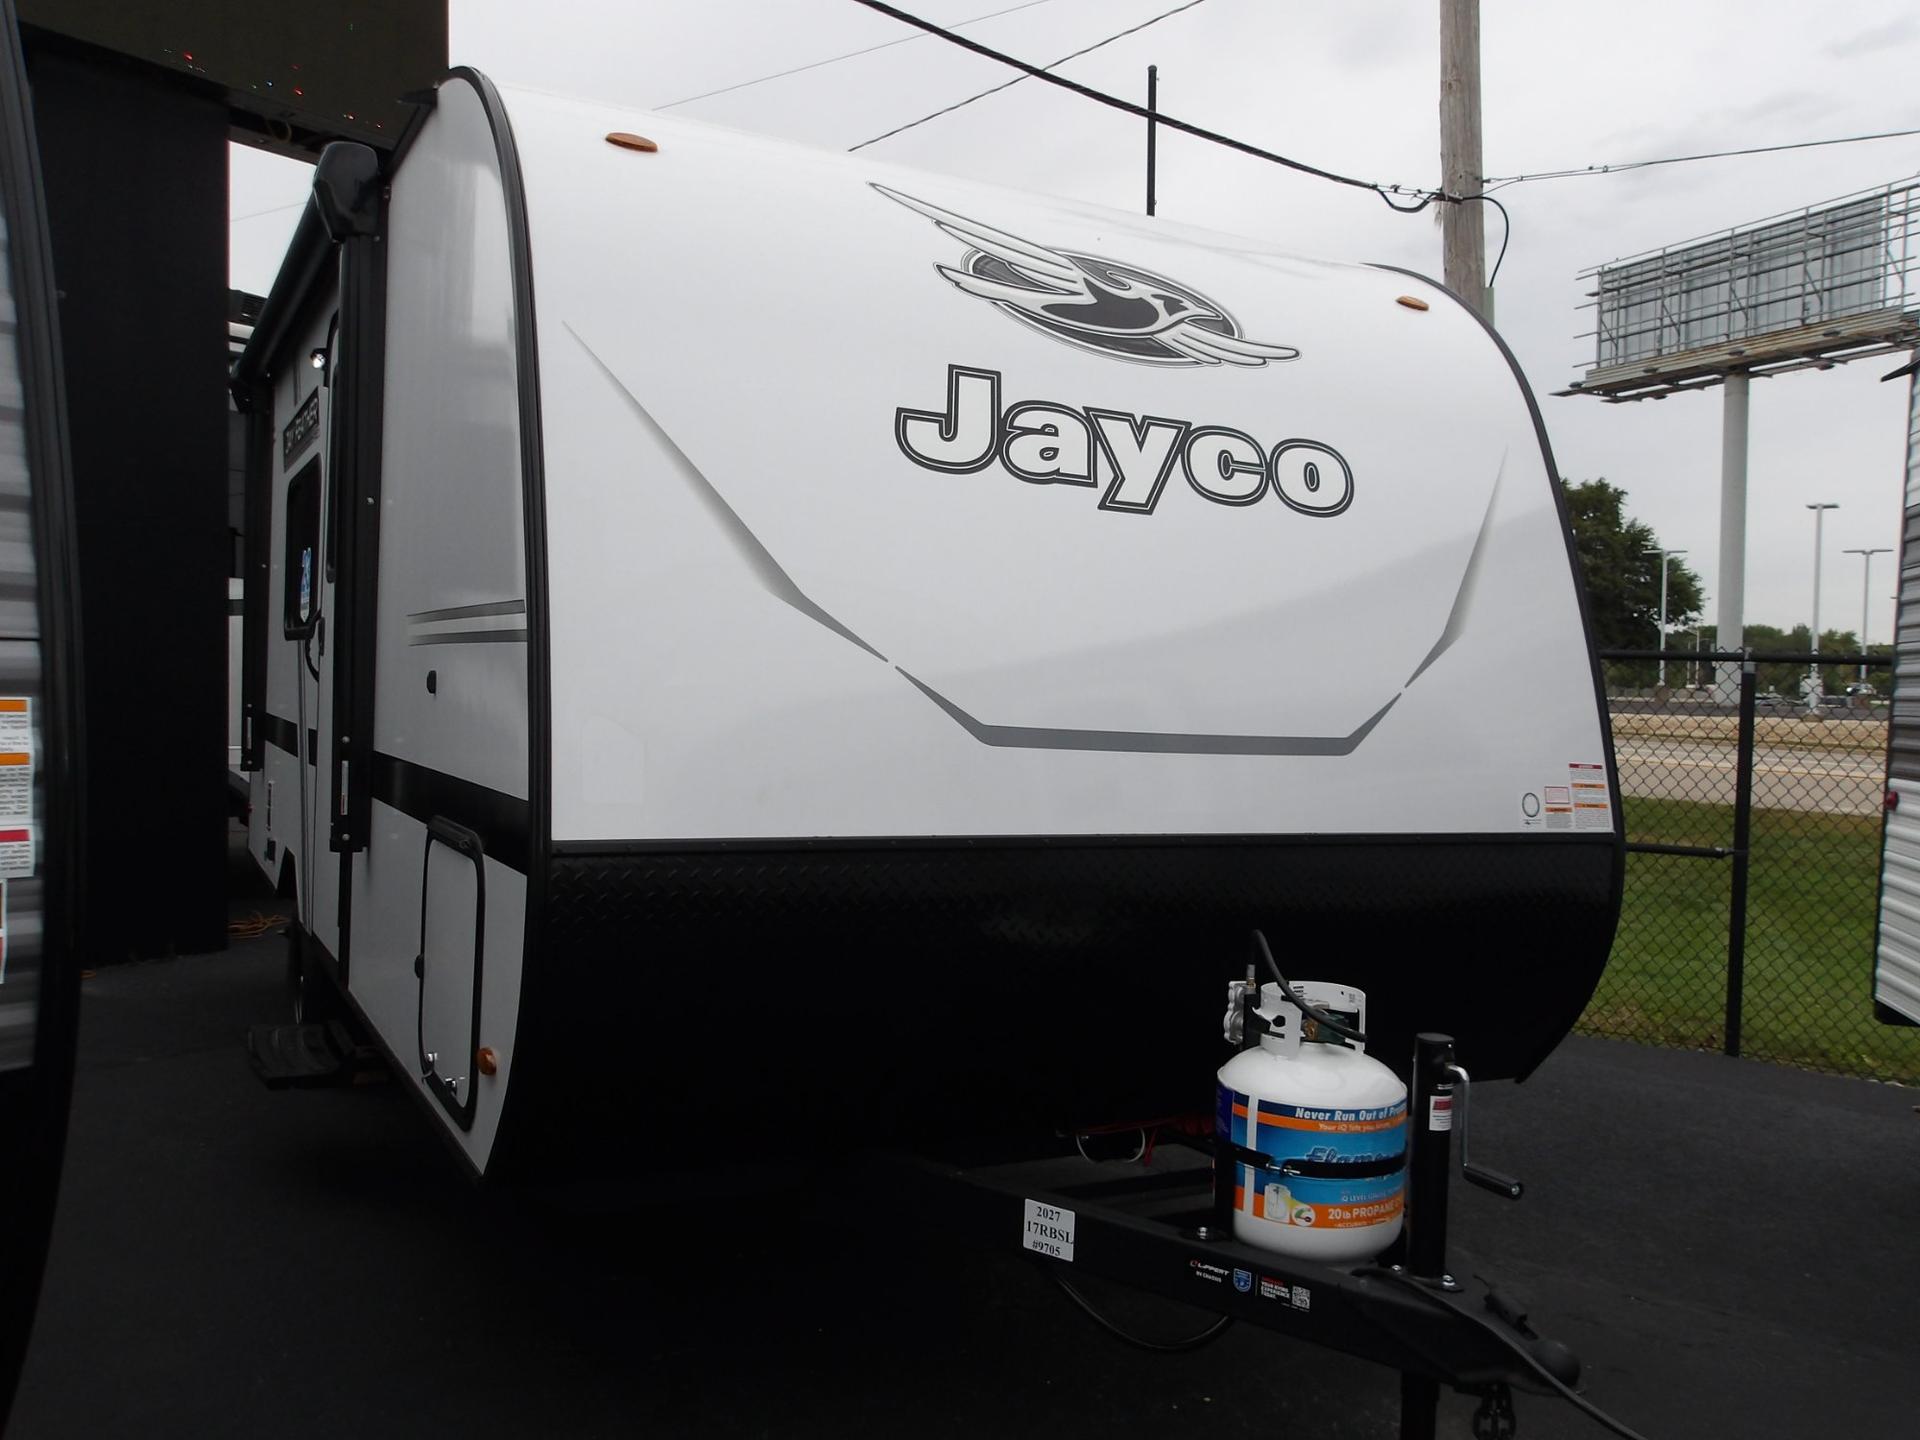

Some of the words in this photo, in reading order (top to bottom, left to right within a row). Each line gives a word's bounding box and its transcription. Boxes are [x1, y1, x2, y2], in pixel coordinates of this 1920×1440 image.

[895, 363, 1355, 518] Jayco
[1295, 1107, 1331, 1121] Never
[1334, 1111, 1356, 1121] Run
[1359, 1110, 1377, 1121] Out
[1037, 1206, 1061, 1222] 2027
[1328, 1208, 1342, 1220] 20
[1027, 1220, 1074, 1245] 17RBSL
[1032, 1240, 1061, 1256] #9705
